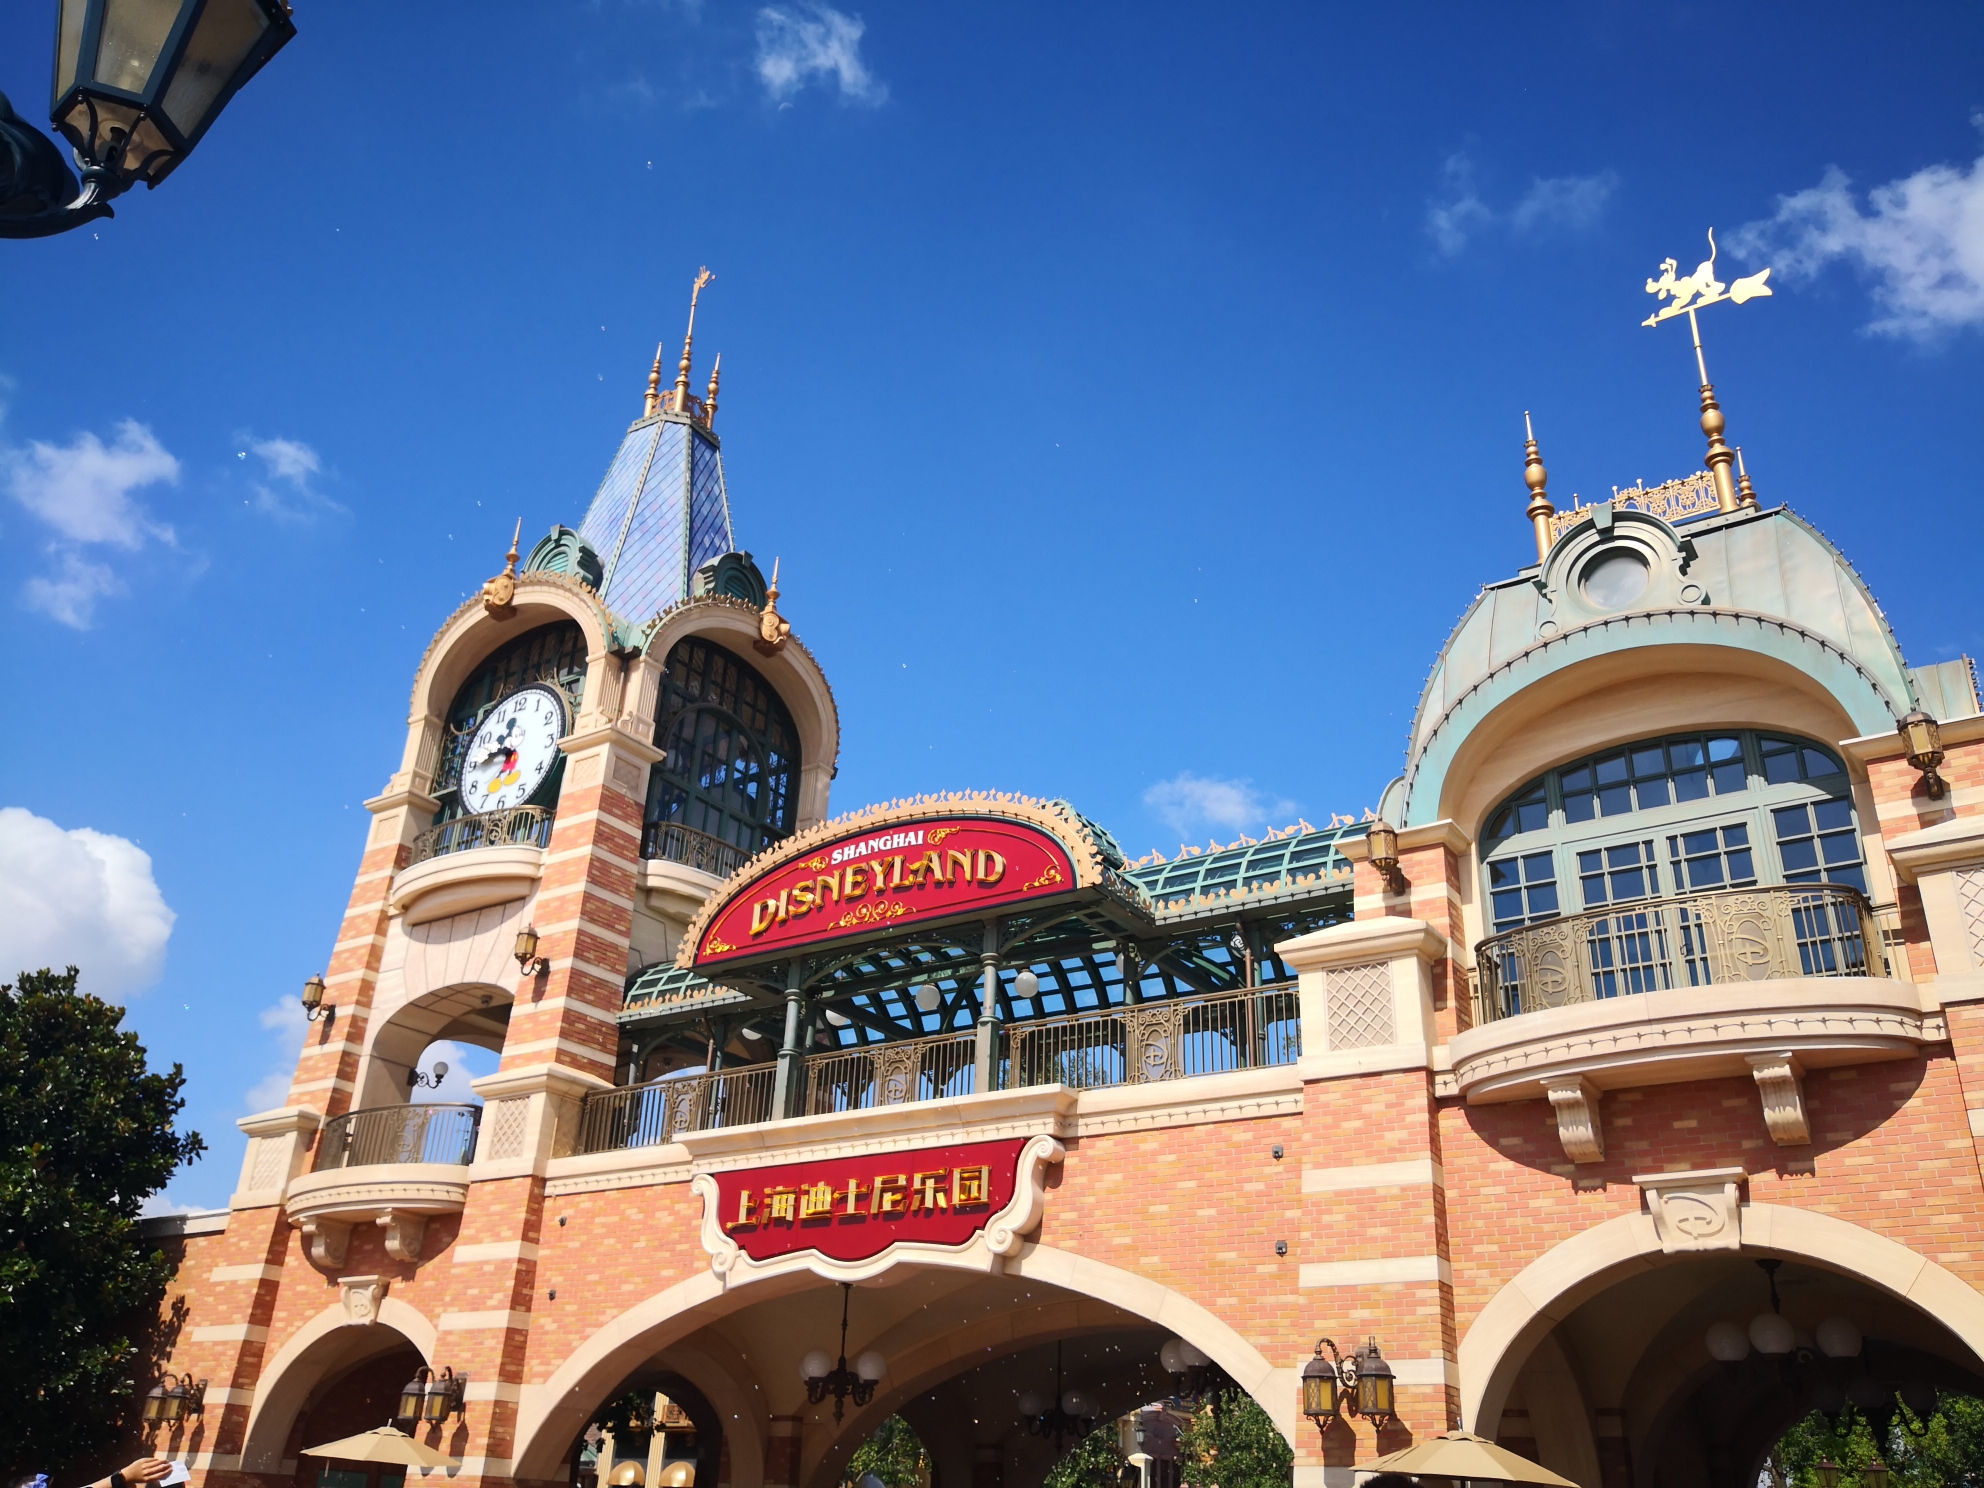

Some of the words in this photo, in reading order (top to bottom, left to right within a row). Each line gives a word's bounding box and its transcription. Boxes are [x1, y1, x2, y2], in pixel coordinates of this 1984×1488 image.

[513, 697, 527, 713] 12
[534, 698, 541, 712] 1
[496, 710, 506, 725] 11
[543, 711, 554, 726] 2
[478, 732, 492, 748] 10
[545, 733, 554, 748] 3
[468, 761, 477, 773] 9
[535, 761, 544, 775] 4
[469, 781, 478, 795] 8
[516, 783, 527, 799] 5
[480, 793, 490, 809] 7
[497, 796, 506, 809] 6
[830, 830, 925, 866] SHANGHAI
[748, 848, 1007, 937] DISNEYLAND
[726, 1165, 993, 1230] 上海迪士尼乐园
